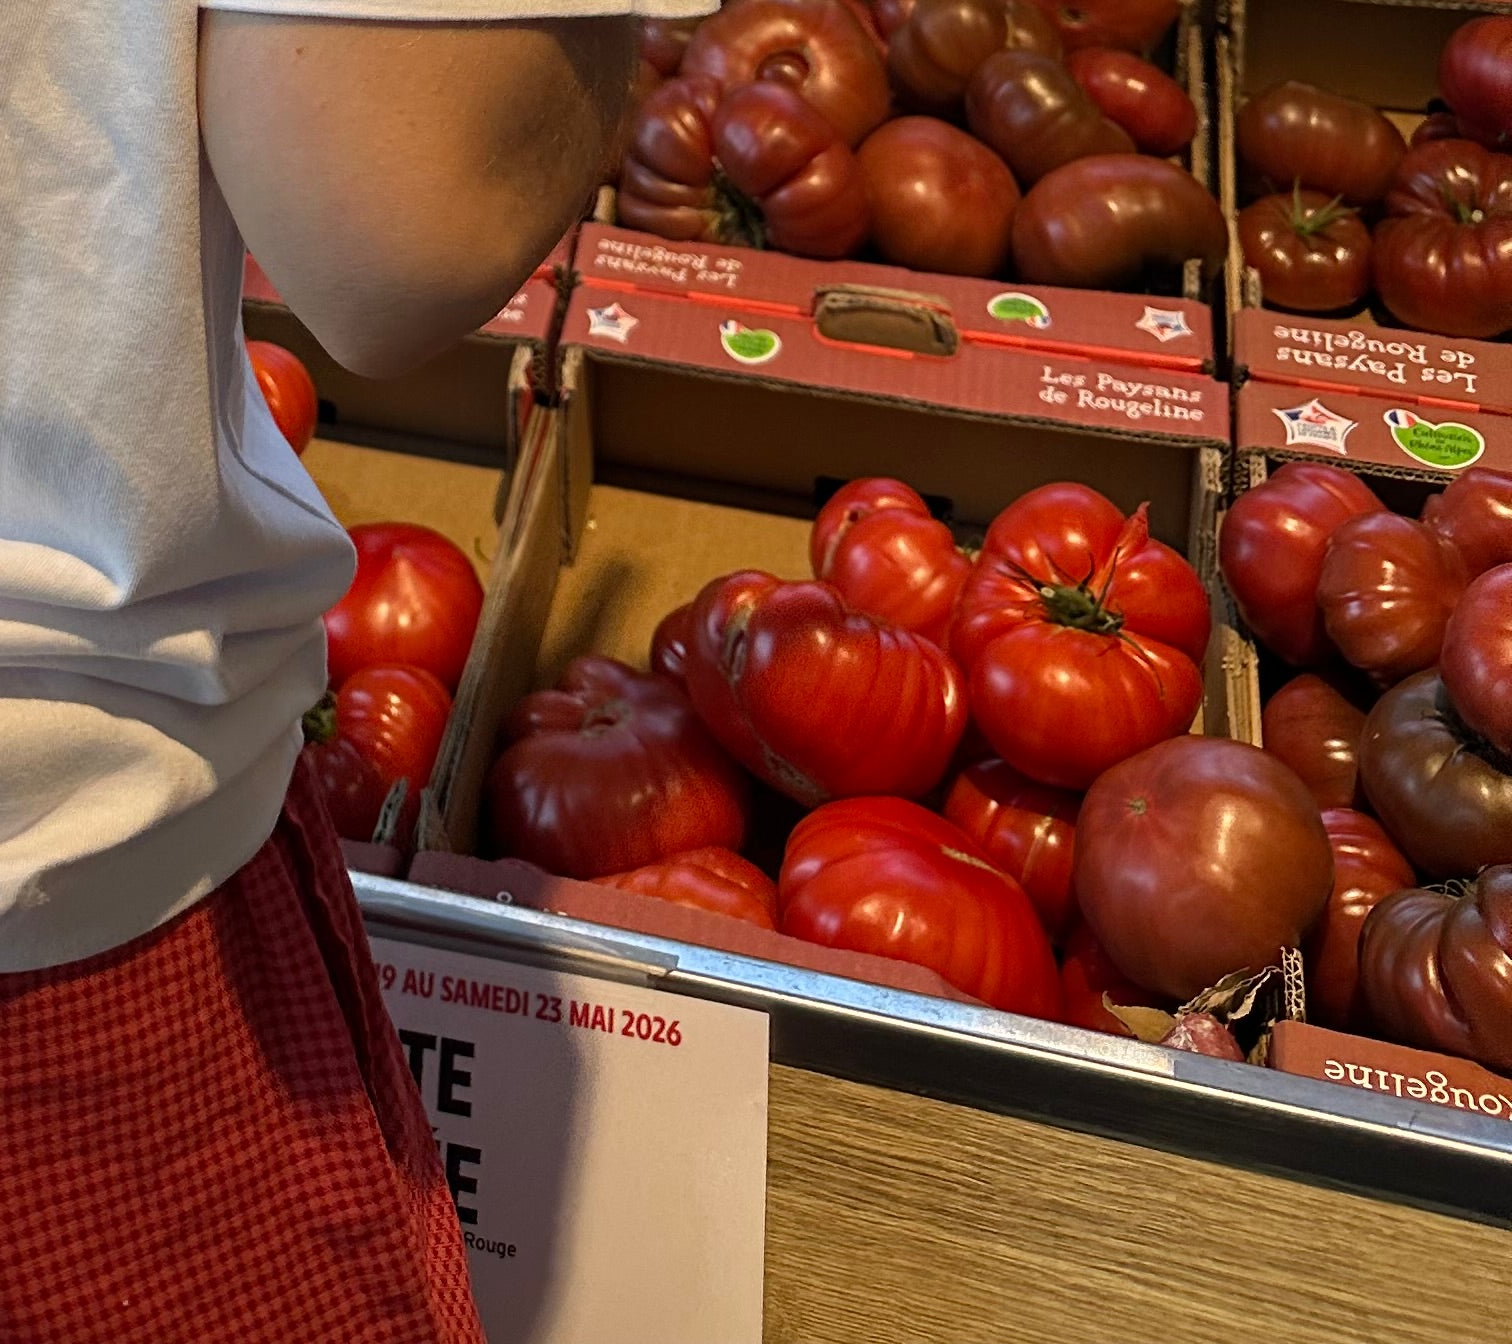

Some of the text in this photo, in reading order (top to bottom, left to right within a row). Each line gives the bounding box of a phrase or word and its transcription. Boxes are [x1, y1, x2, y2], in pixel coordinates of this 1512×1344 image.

[1273, 325, 1476, 369] de Rougeline
[1040, 365, 1202, 403] Les Paysans
[1276, 347, 1479, 394] Les Paysans
[1039, 385, 1205, 421] de Rougeline
[403, 969, 434, 999] AU
[440, 975, 529, 1017] SAMEDI
[536, 994, 562, 1023] 23
[569, 1000, 614, 1033] MAI
[621, 1010, 682, 1047] 2026
[464, 1231, 517, 1259] Rouge
